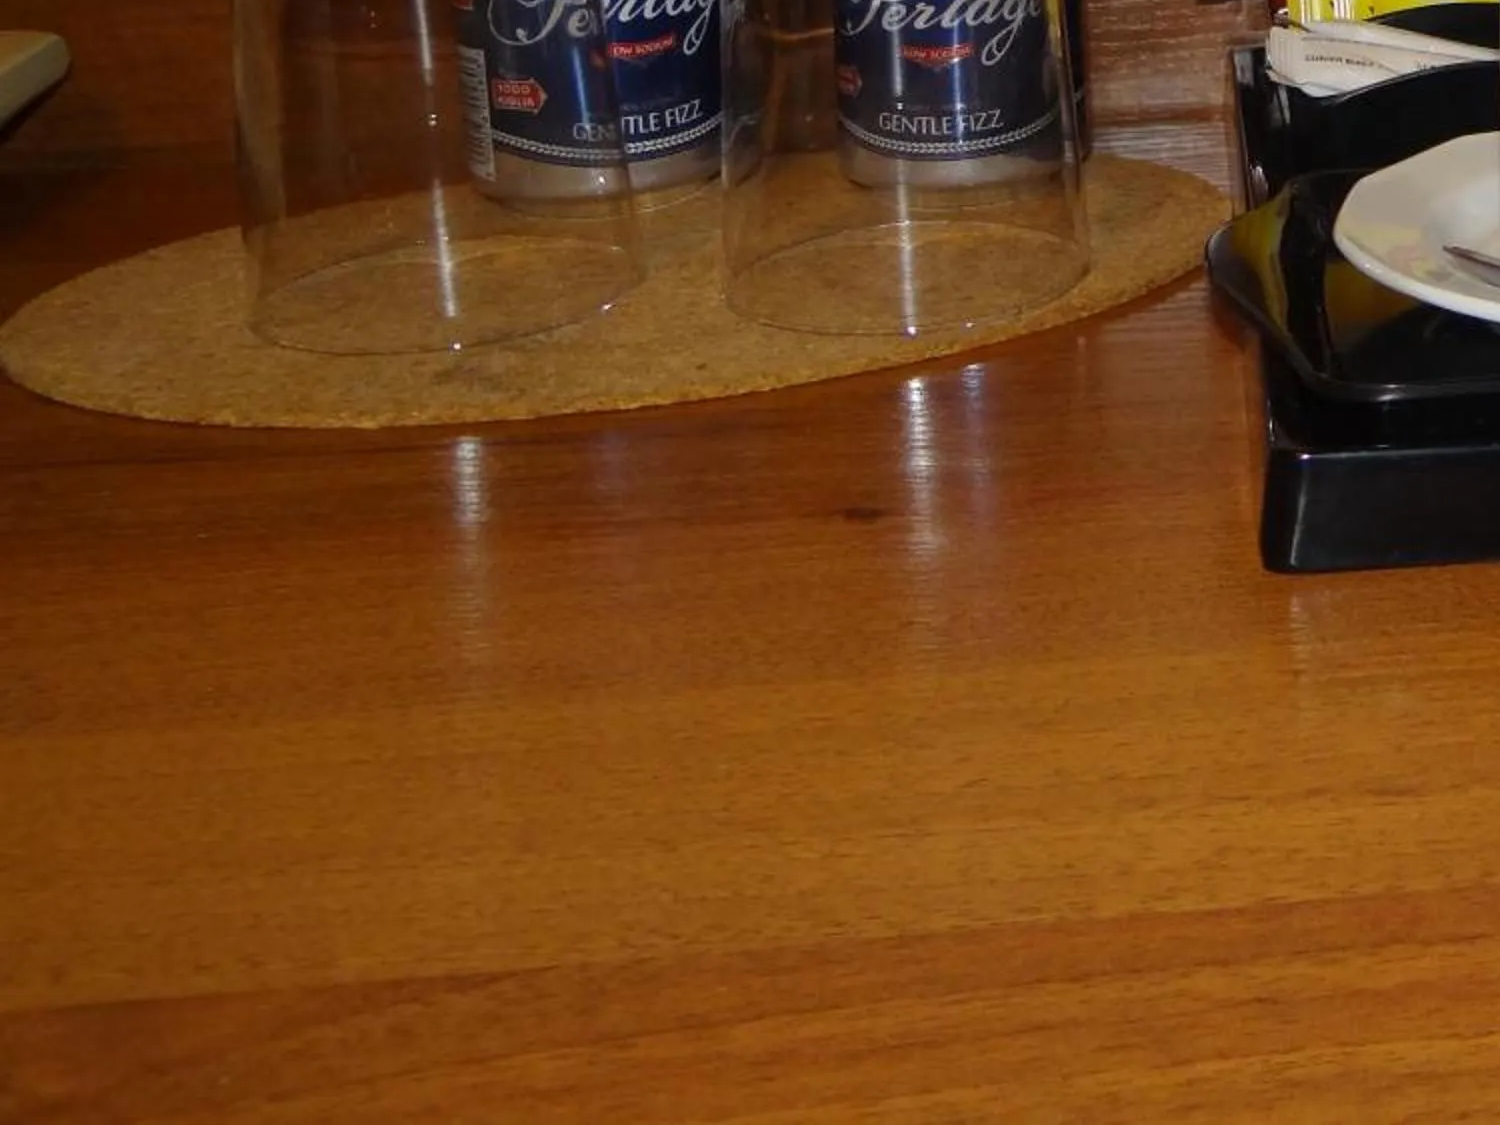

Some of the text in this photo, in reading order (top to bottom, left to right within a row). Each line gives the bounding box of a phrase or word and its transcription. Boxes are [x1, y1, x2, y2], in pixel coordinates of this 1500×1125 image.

[665, 98, 703, 128] FIZZ
[879, 108, 1004, 136] GENTLE FIZZ
